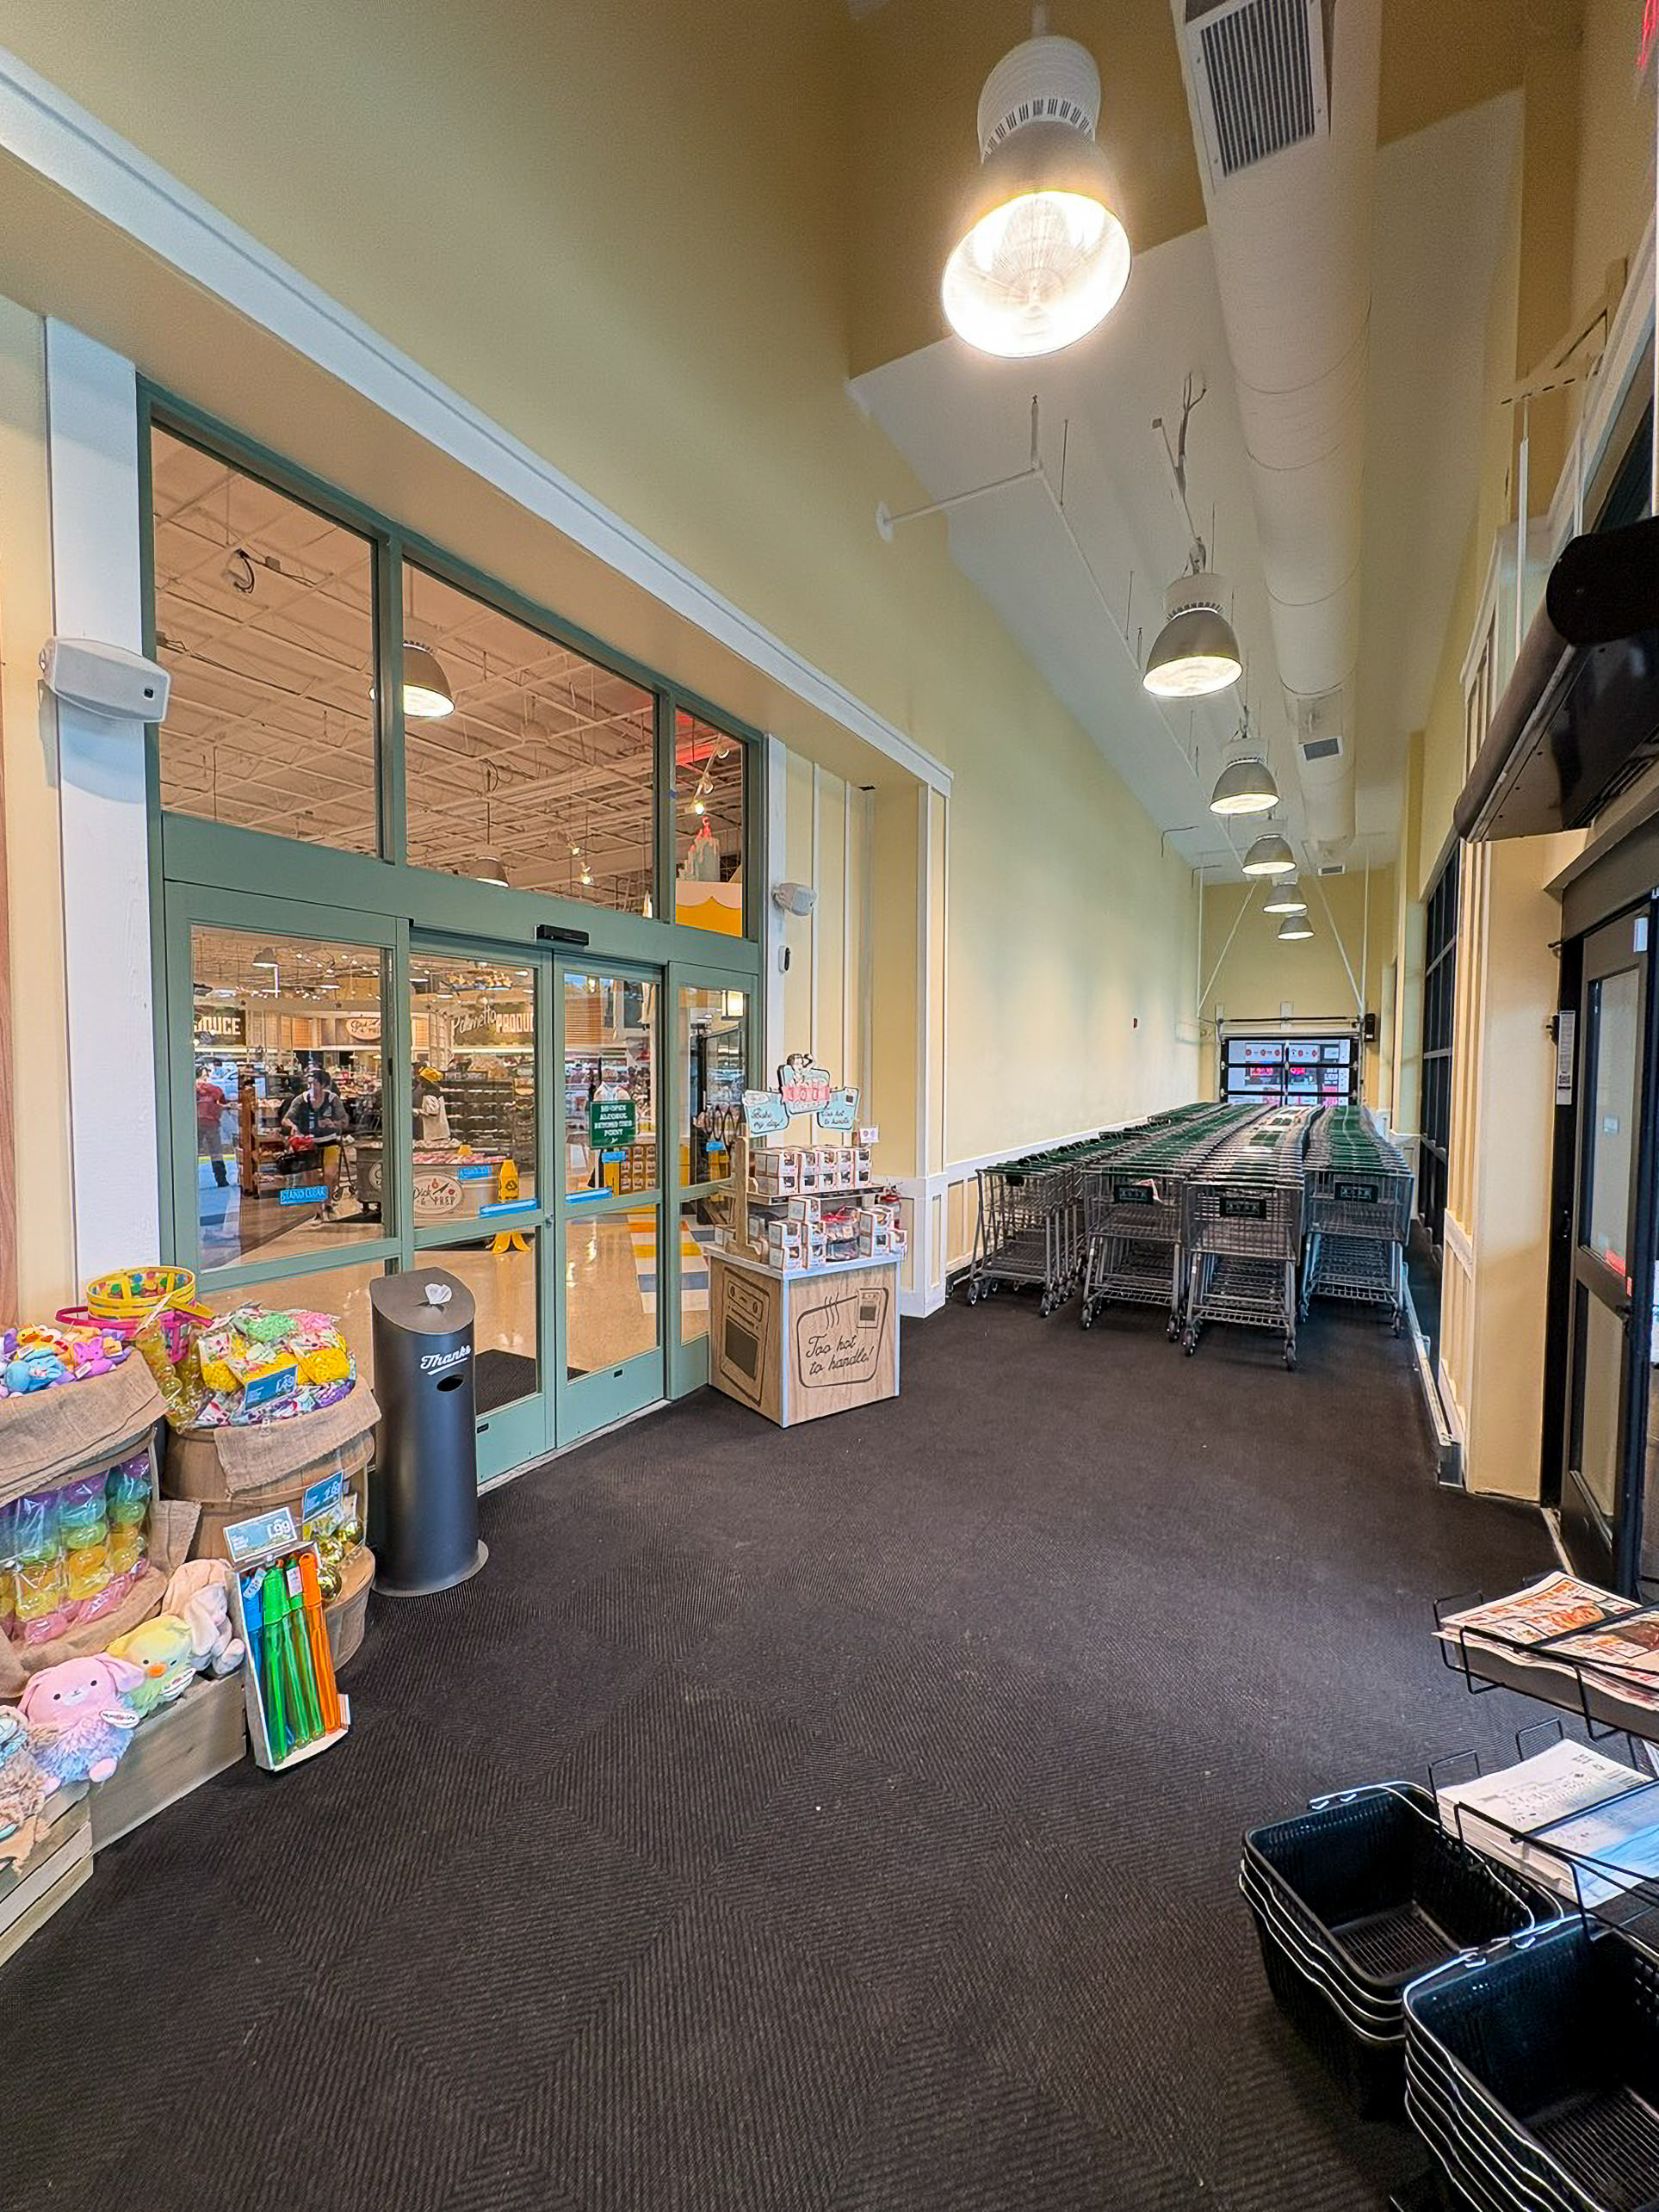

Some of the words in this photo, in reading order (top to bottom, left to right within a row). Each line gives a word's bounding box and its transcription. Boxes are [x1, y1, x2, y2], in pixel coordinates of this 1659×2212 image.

[420, 1344, 472, 1369] Thanks
[806, 1333, 833, 1358] Too
[836, 1335, 857, 1352] hot
[809, 1361, 826, 1375] to
[828, 1345, 875, 1370] handle!
